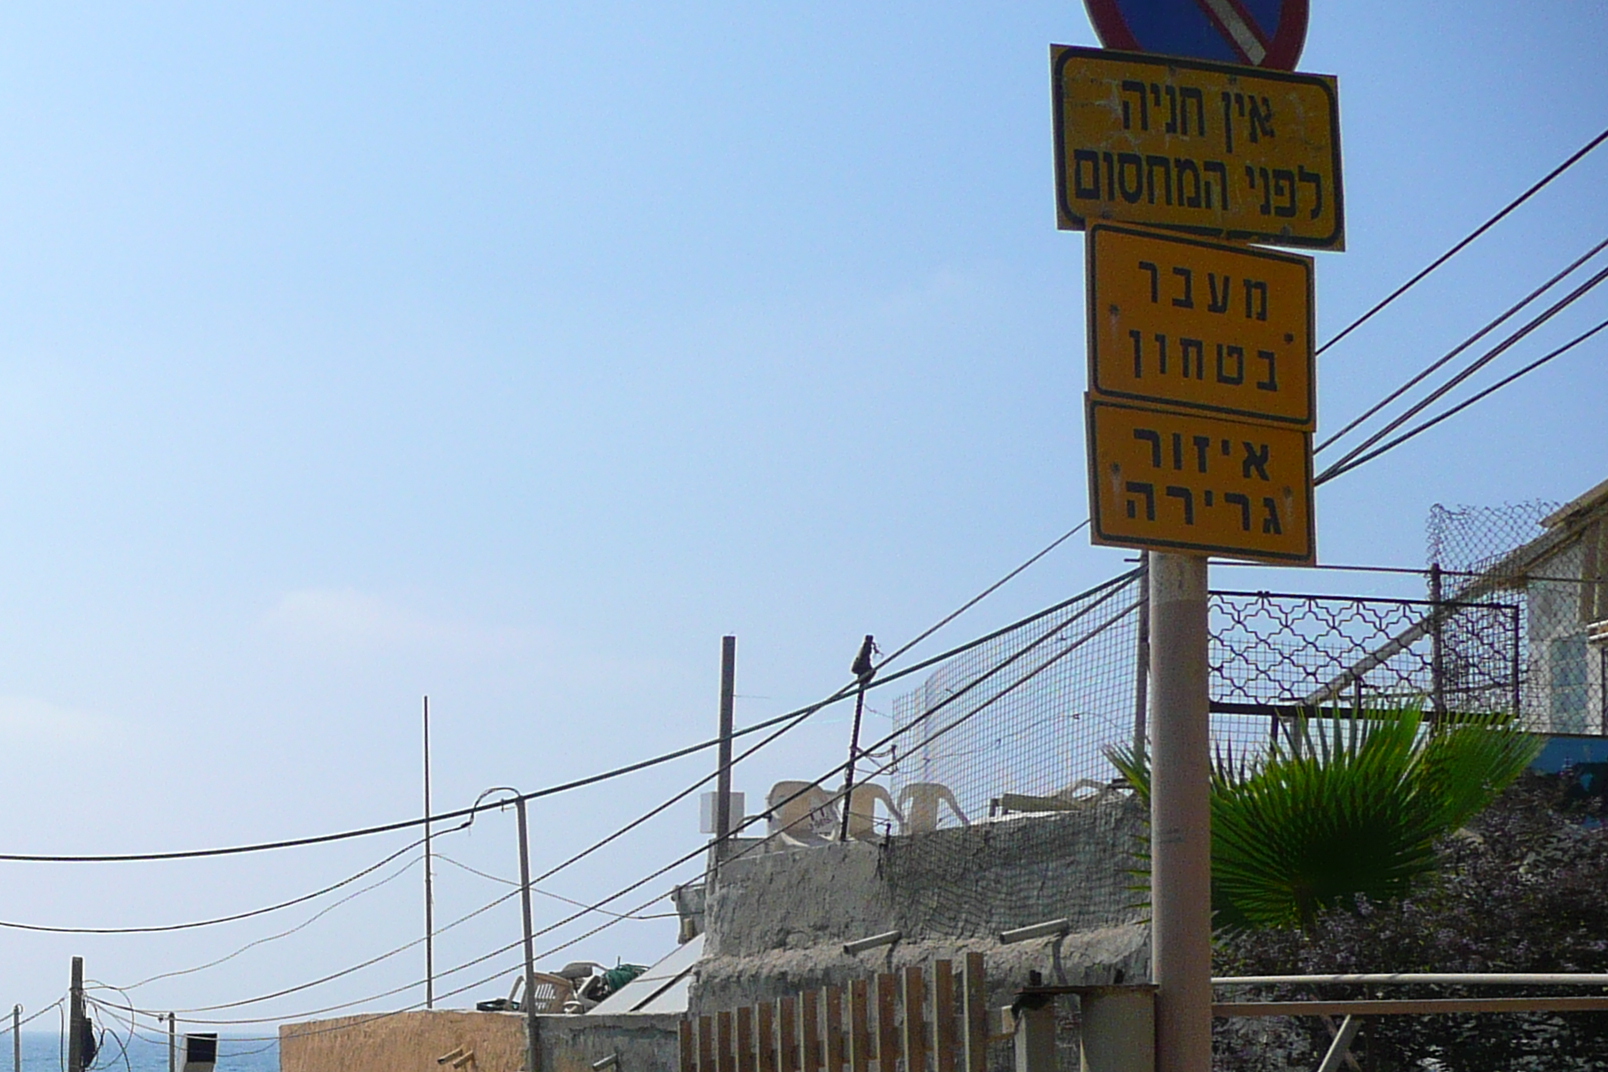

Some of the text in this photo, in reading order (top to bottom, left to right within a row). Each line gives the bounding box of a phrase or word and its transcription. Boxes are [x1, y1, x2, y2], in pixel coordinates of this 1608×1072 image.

[1122, 79, 1275, 154] אין חניה
[1073, 148, 1323, 220] לפני המחסום
[1138, 260, 1268, 322] מעבר
[1128, 329, 1278, 392] בטחון
[1133, 428, 1270, 482] איזור
[1125, 480, 1283, 535] גרירה
